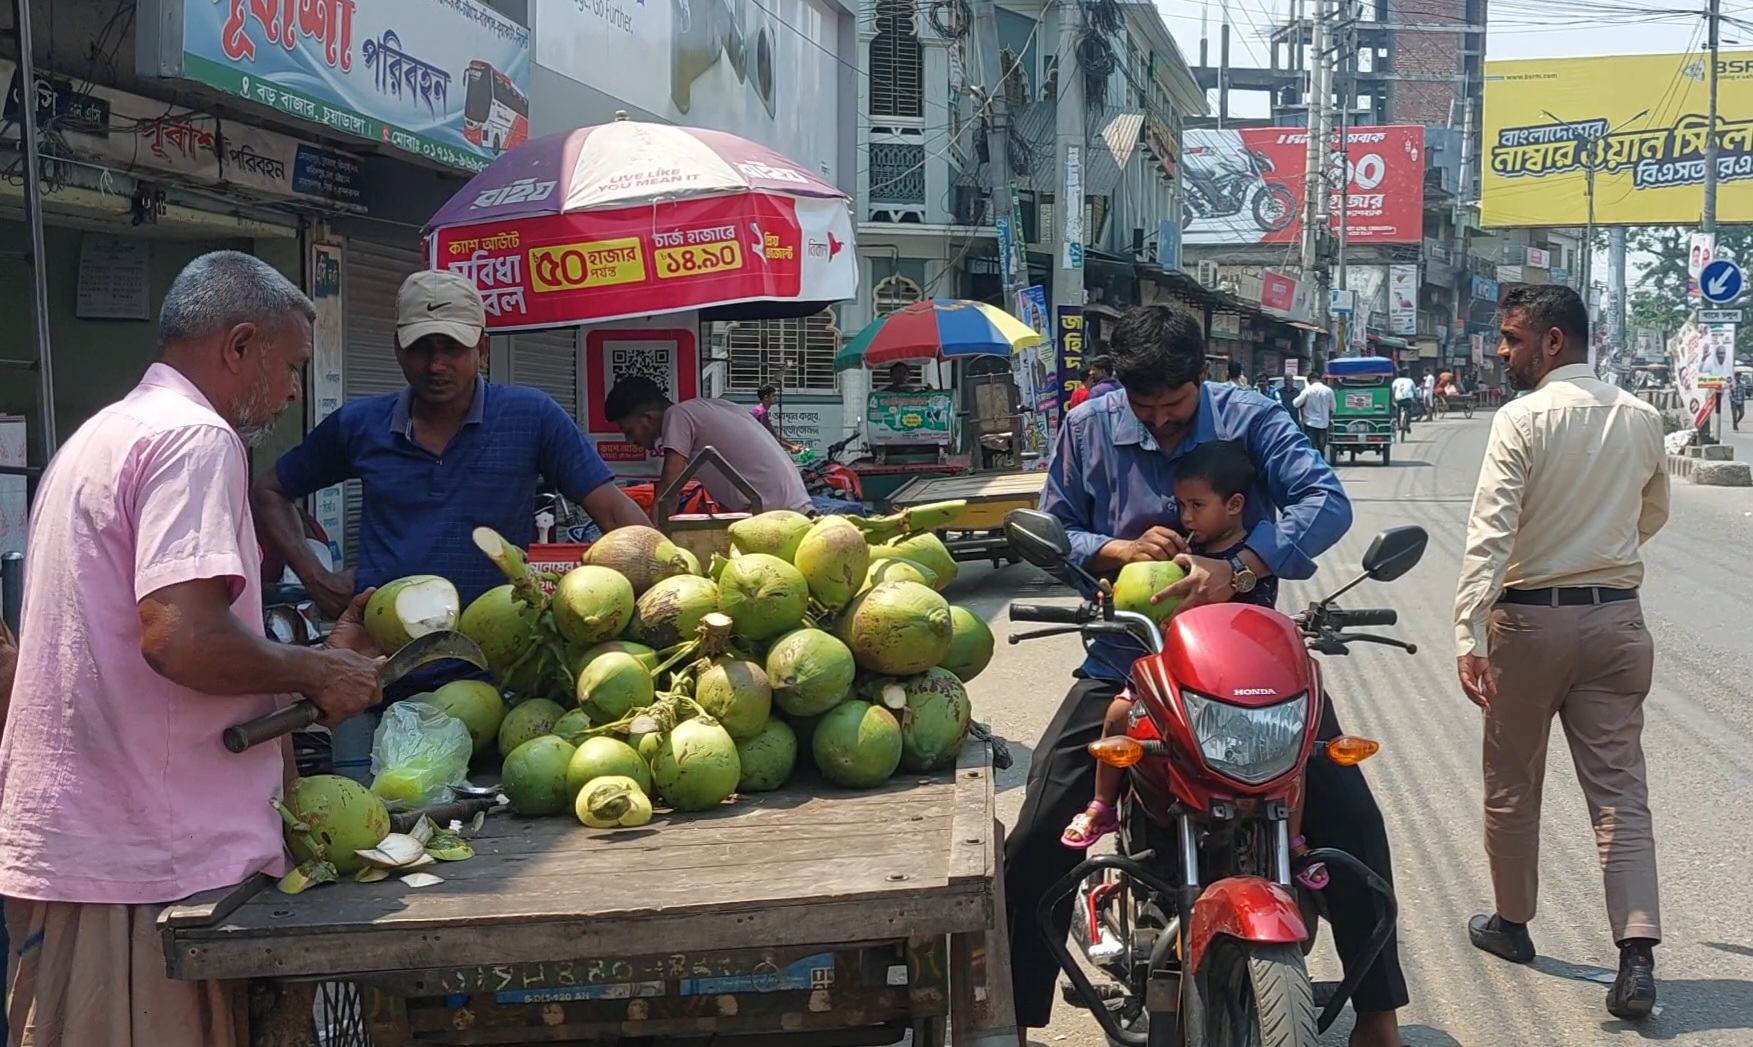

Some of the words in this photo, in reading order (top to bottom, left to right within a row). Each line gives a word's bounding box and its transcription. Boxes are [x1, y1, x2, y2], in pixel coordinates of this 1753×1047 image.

[363, 29, 451, 121] পরিবহন
[257, 81, 276, 106] বড়
[1500, 121, 1607, 147] বাংলাদেশের
[230, 145, 286, 181] পরিবহন
[1492, 140, 1578, 173] নাম্বার
[598, 182, 631, 193] YOU
[635, 175, 682, 187] MEAN
[685, 173, 700, 181] IT
[610, 173, 644, 184] LIVE
[648, 168, 682, 178] LIKE
[449, 239, 479, 256] ক্যাশ
[655, 228, 685, 249] চার্জ
[687, 225, 736, 244] হাজারে
[588, 247, 637, 266] হাজার
[591, 265, 617, 280] পর্যন্ত
[1233, 688, 1278, 696] HONDA
